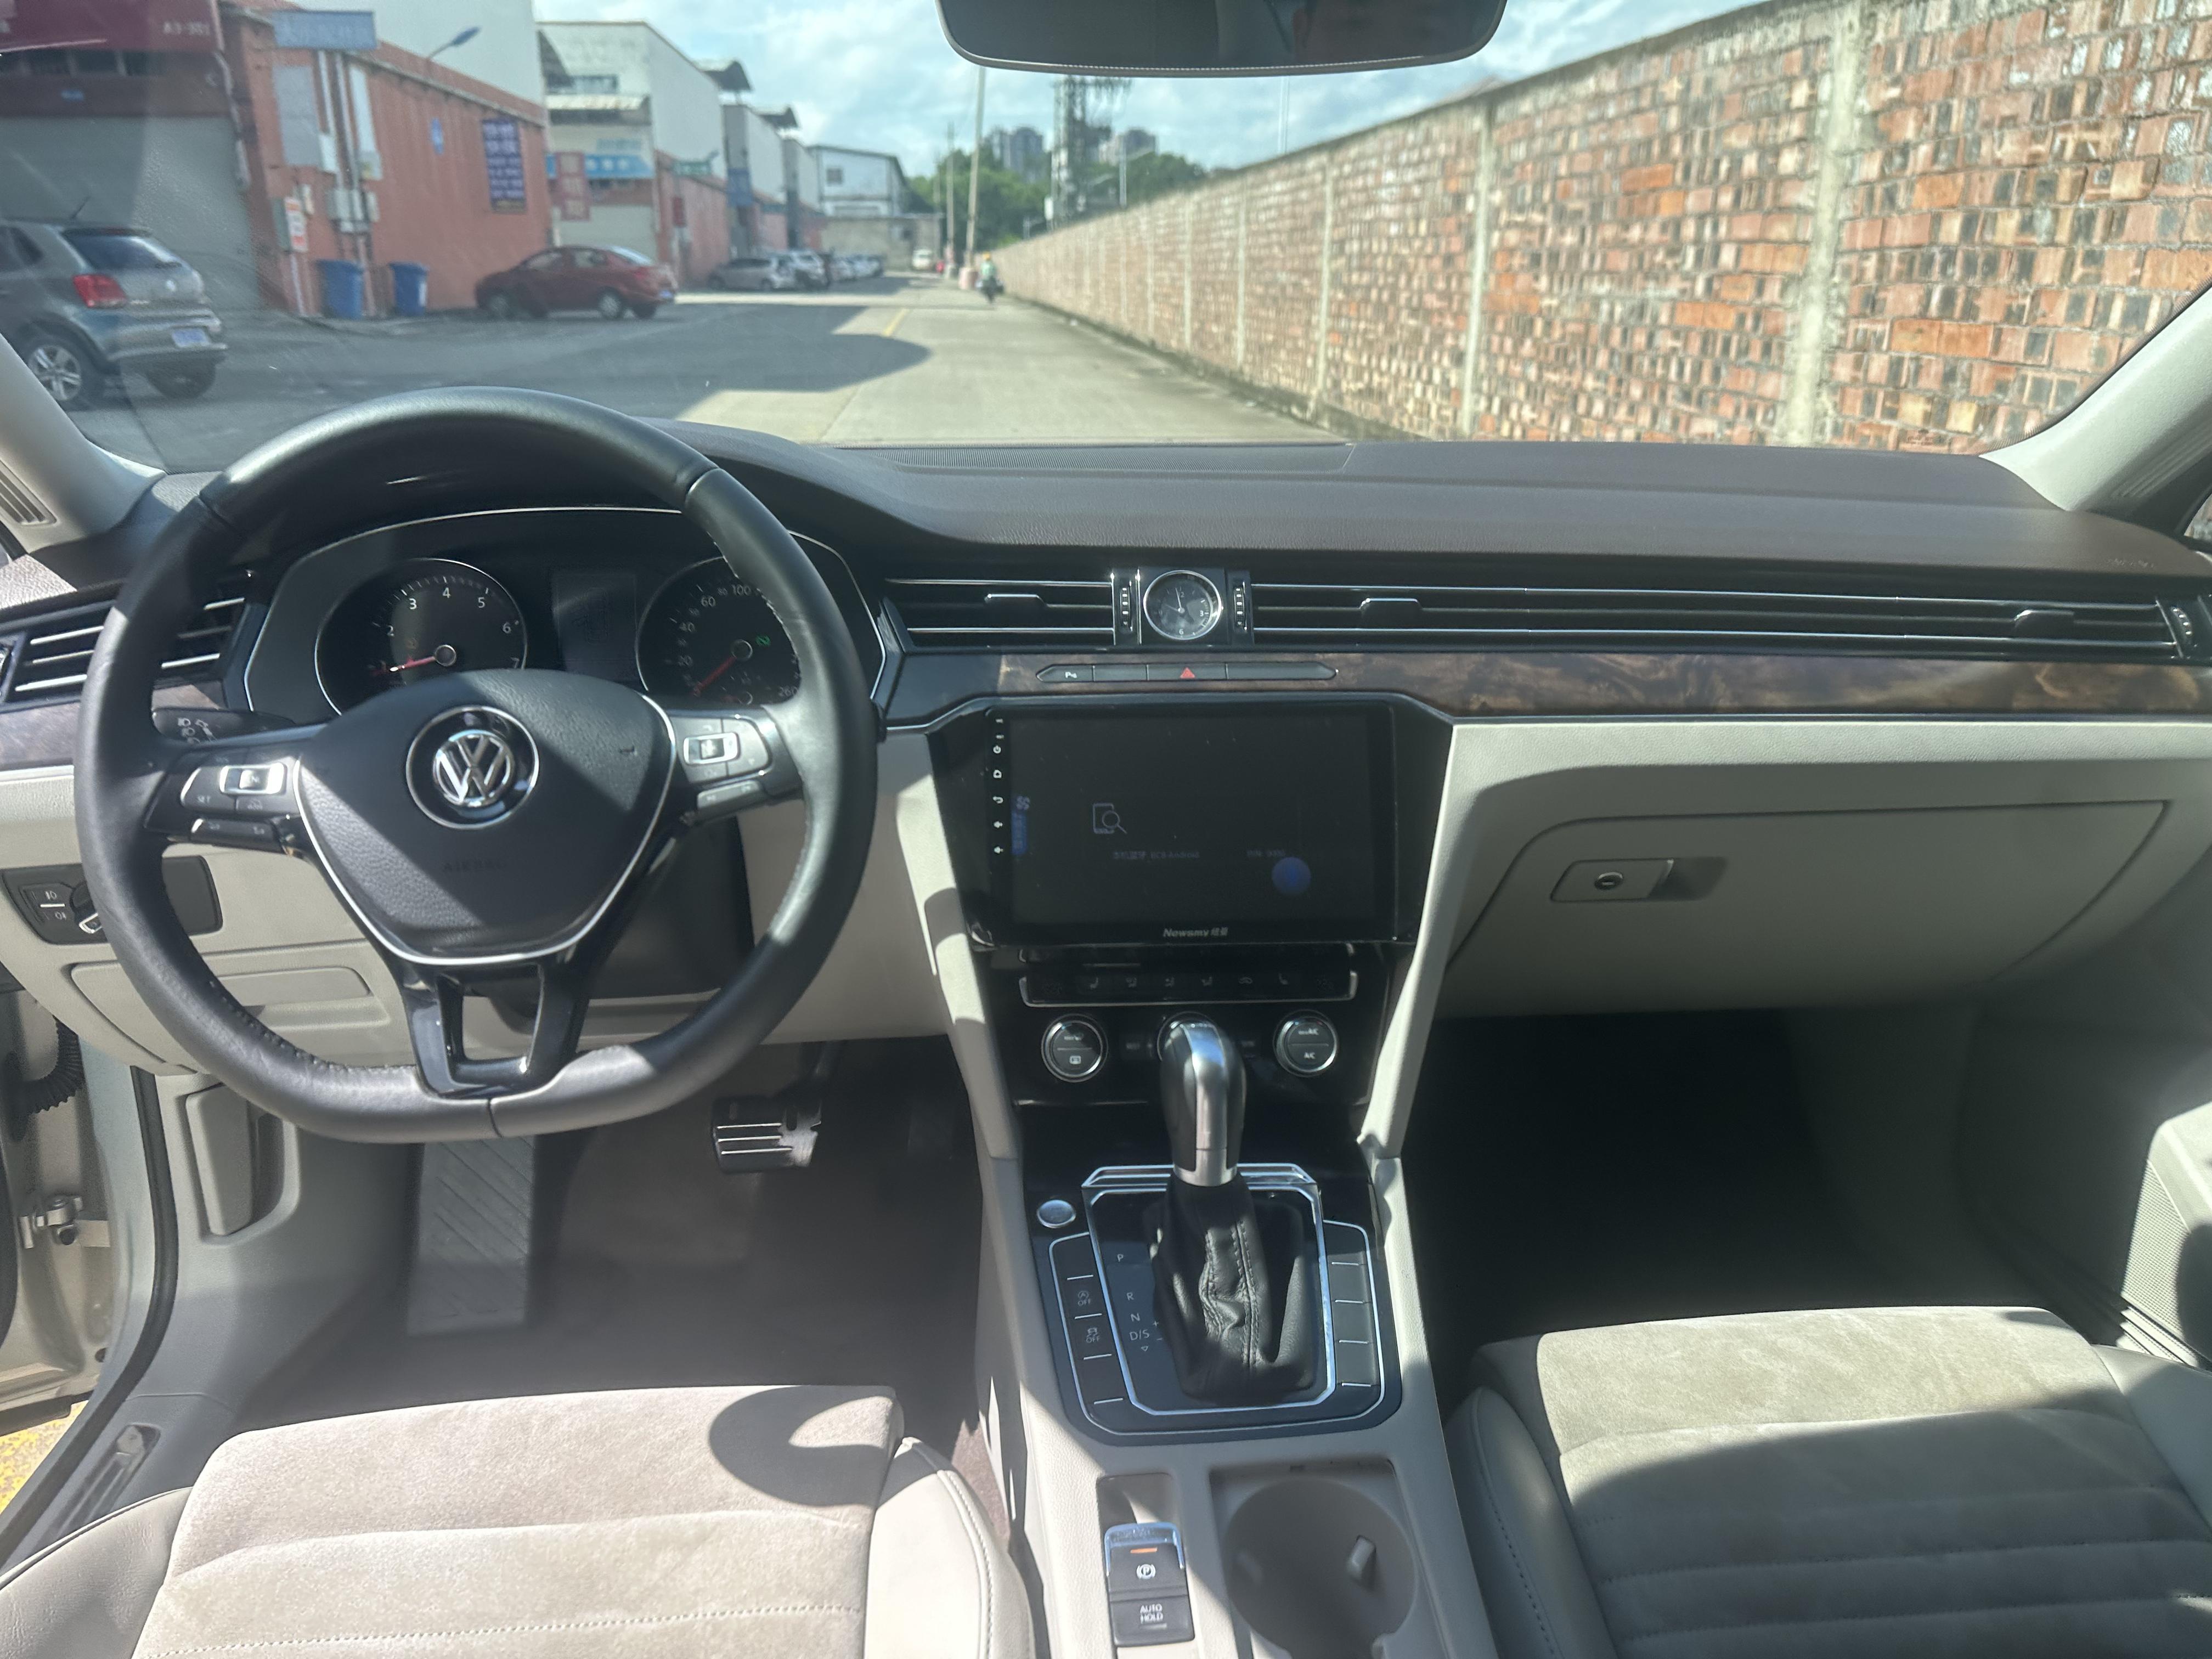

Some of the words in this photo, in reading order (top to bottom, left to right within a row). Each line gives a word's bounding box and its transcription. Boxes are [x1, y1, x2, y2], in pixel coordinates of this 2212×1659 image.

[443, 588, 451, 599] 4
[731, 584, 751, 595] 100
[408, 598, 417, 610] 3
[478, 597, 486, 608] 5
[701, 595, 716, 607] 60
[387, 625, 395, 637] 2
[503, 622, 511, 634] 6
[679, 621, 696, 633] 40
[1163, 928, 1209, 938] Newsmy
[1117, 1254, 1124, 1262] P
[1126, 1291, 1135, 1301] R
[1077, 1298, 1091, 1306] OFF
[1131, 1313, 1141, 1322] N
[1086, 1335, 1101, 1344] OFF
[1128, 1329, 1150, 1341] D/S
[1140, 1603, 1163, 1613] AUTO
[1140, 1612, 1164, 1624] HOLD
